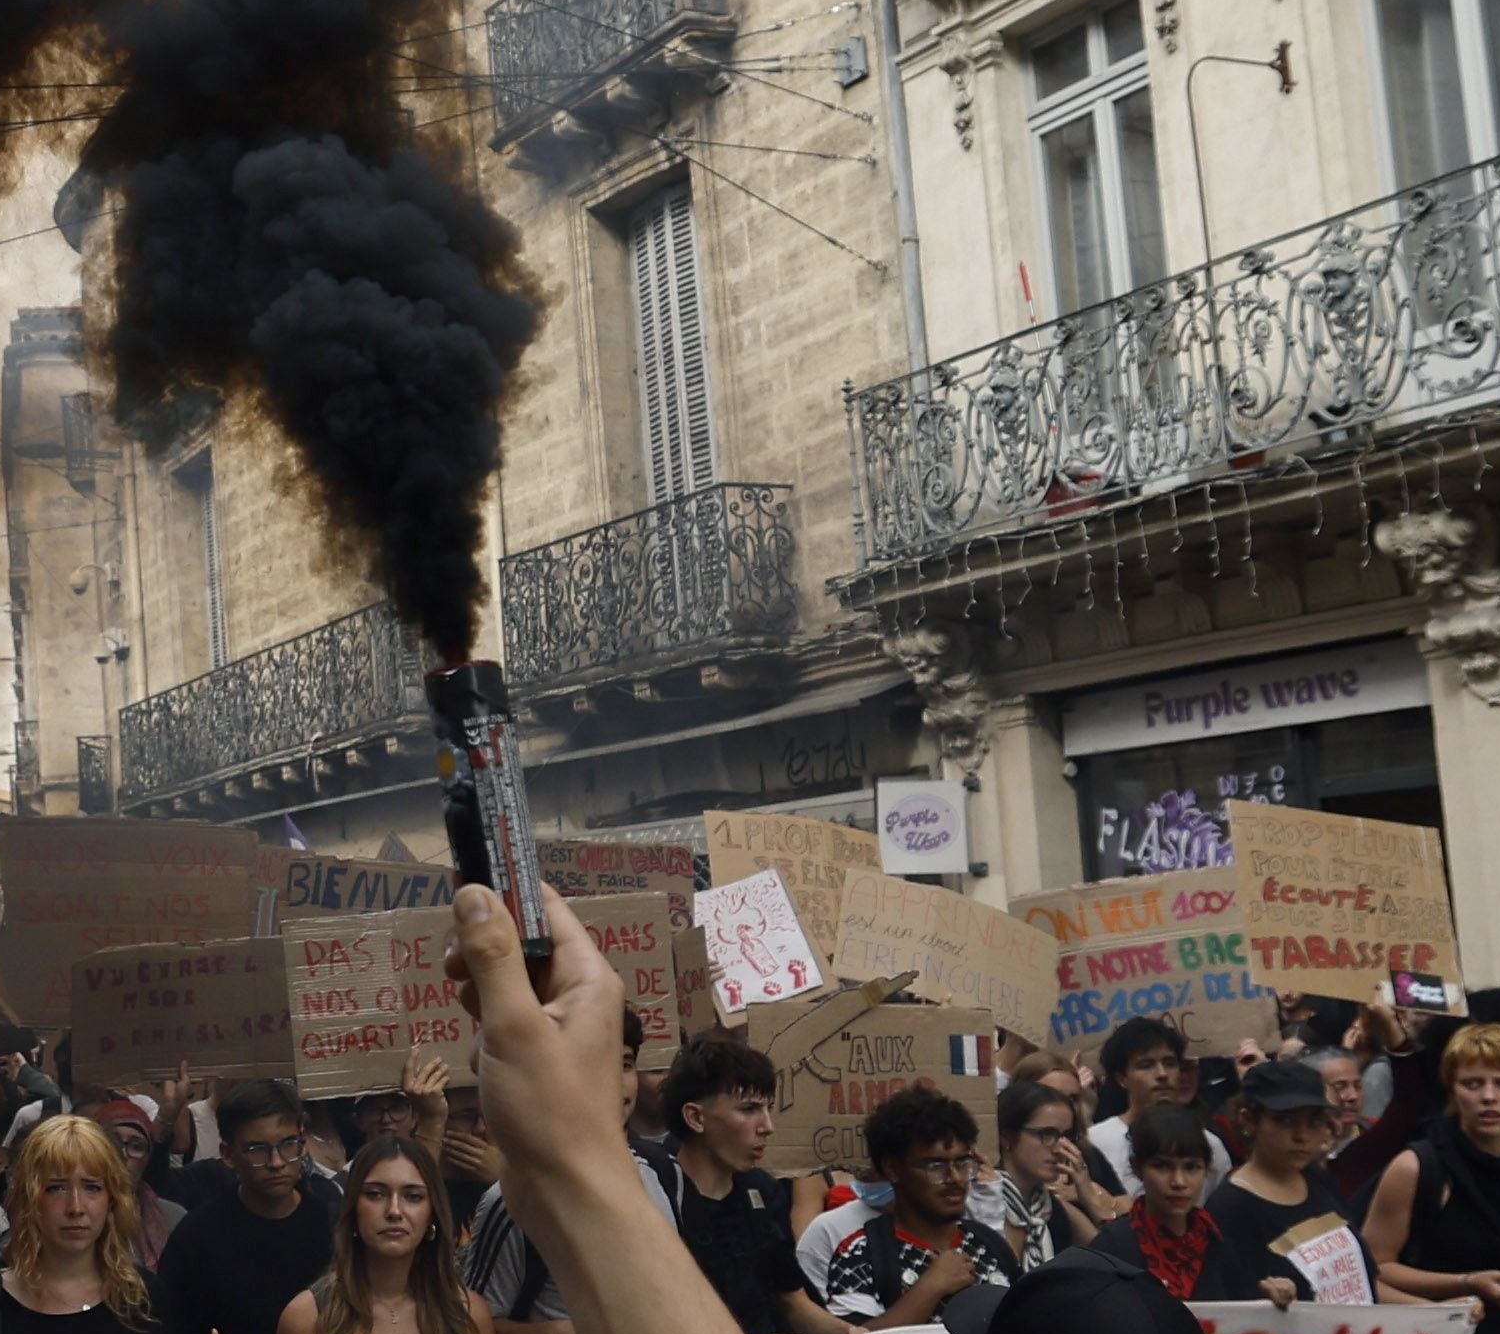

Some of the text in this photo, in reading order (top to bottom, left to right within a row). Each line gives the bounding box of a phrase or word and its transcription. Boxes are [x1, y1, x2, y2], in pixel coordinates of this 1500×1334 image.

[1144, 667, 1360, 730] Purple wave
[744, 818, 823, 856] PROF
[1236, 816, 1323, 849] TROP
[19, 837, 108, 874] NOS
[148, 841, 233, 876] VOIX
[1252, 850, 1321, 882] POUR
[597, 873, 649, 889] FAIRE
[18, 891, 211, 923] SONT NOS
[850, 874, 1051, 970] APPRENDRE
[1026, 901, 1089, 947] ON
[1093, 888, 1165, 934] VEUT
[304, 937, 375, 972] PAS
[390, 936, 433, 970] DE
[1086, 932, 1247, 990] NOTRE BAC
[1251, 934, 1438, 971] TABASSER
[302, 989, 360, 1017] NOS
[376, 982, 462, 1015] QUAR
[636, 968, 670, 997] DE
[1108, 980, 1194, 1022] 100%
[1203, 971, 1236, 1002] DE
